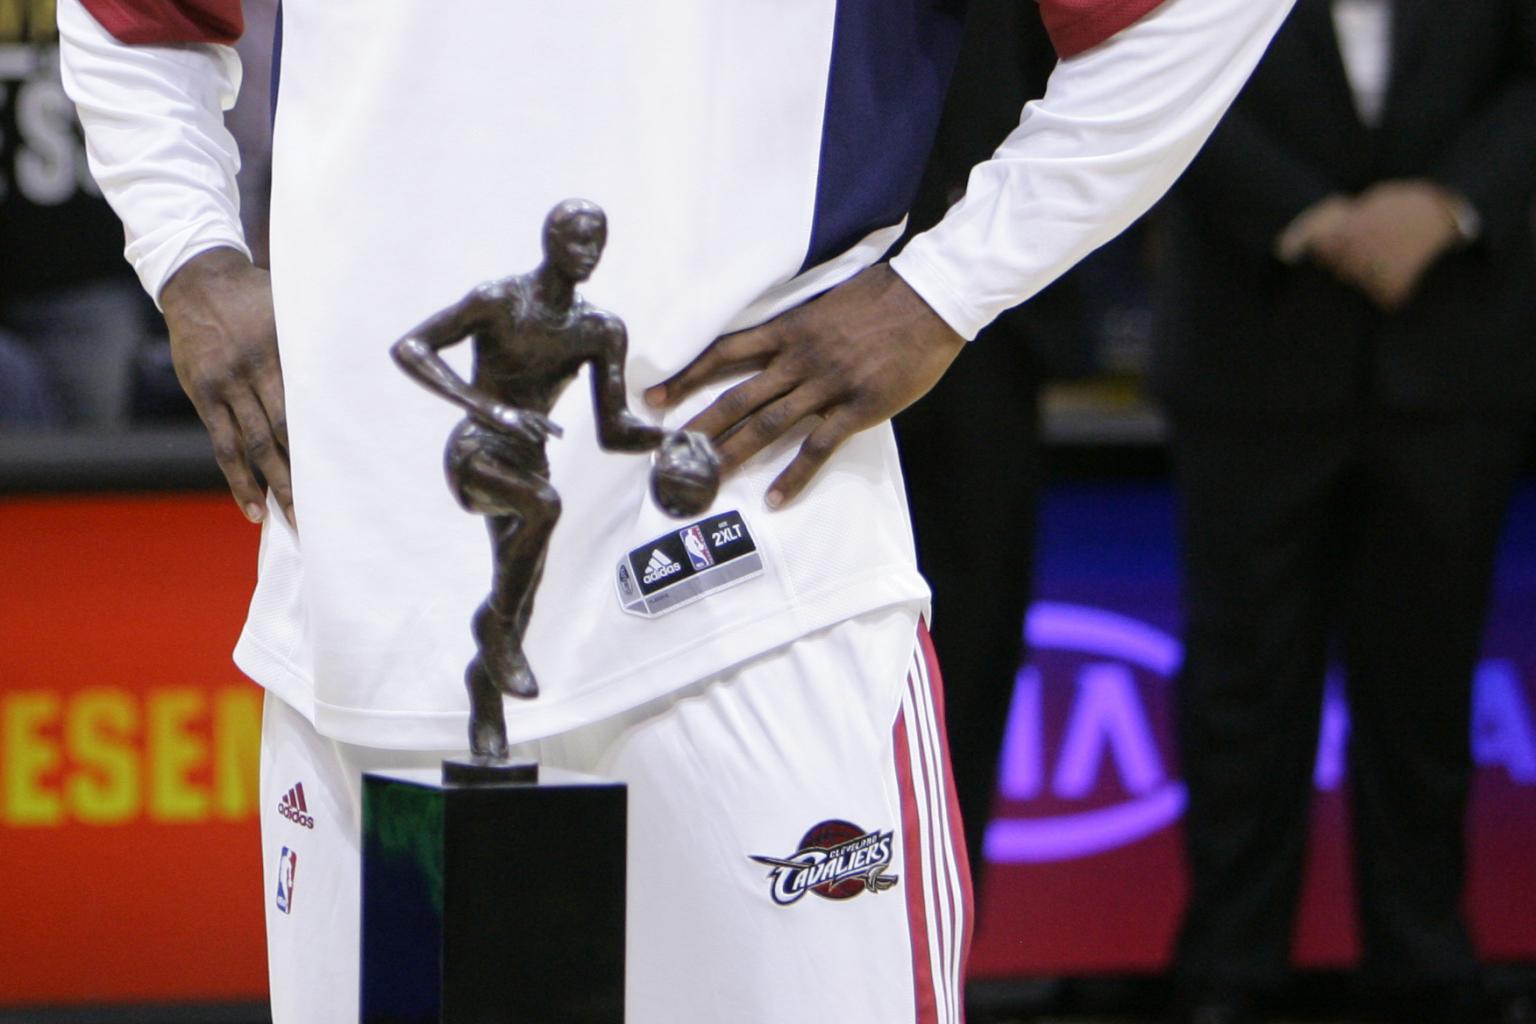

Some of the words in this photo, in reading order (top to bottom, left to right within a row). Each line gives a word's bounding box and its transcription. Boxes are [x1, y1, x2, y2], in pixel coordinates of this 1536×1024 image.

[712, 524, 742, 547] 2XLT
[643, 561, 682, 584] adidas
[278, 803, 314, 829] adidas
[829, 834, 878, 858] CLEVELAND
[772, 837, 890, 905] CAVALIERS
